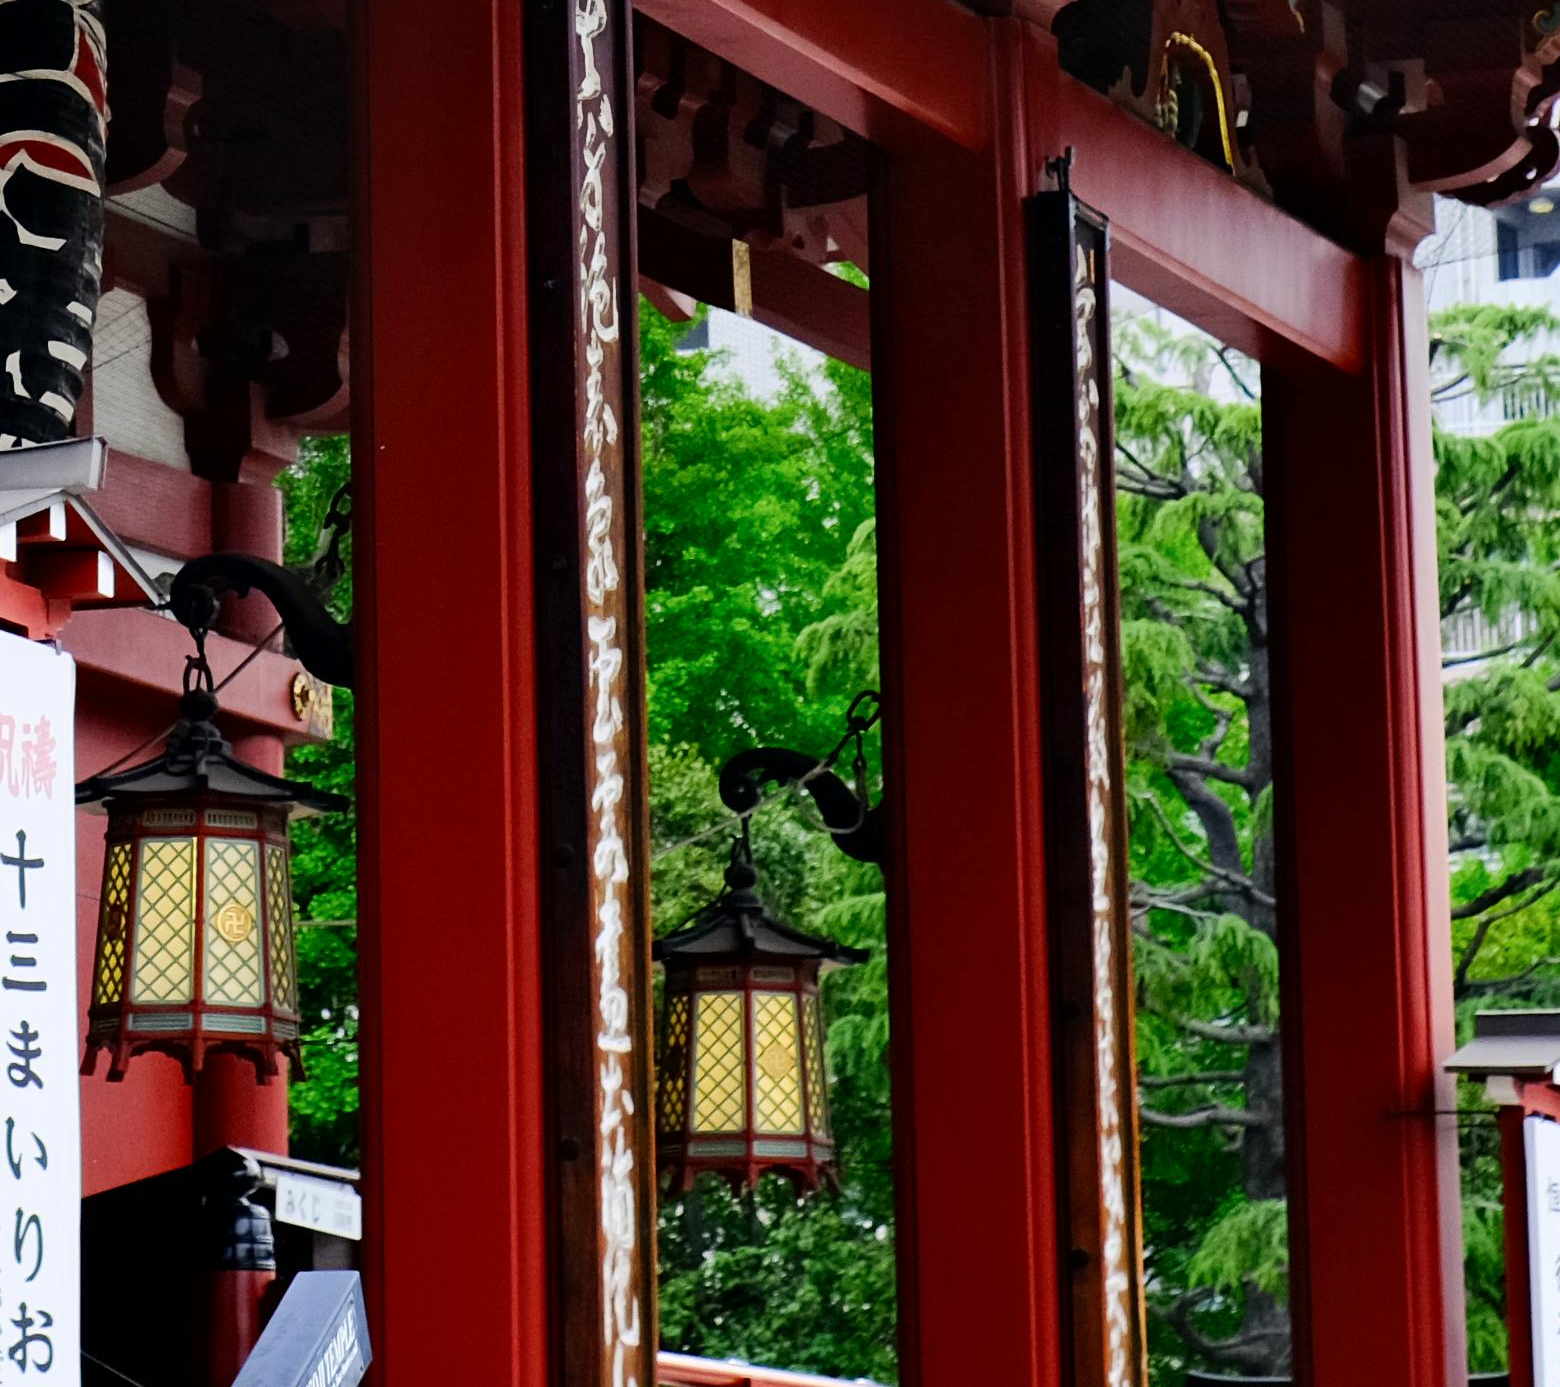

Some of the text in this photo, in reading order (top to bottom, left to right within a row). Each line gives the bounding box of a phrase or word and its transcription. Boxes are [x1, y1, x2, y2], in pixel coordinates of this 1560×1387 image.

[0, 829, 55, 1374] 十三まいりお
